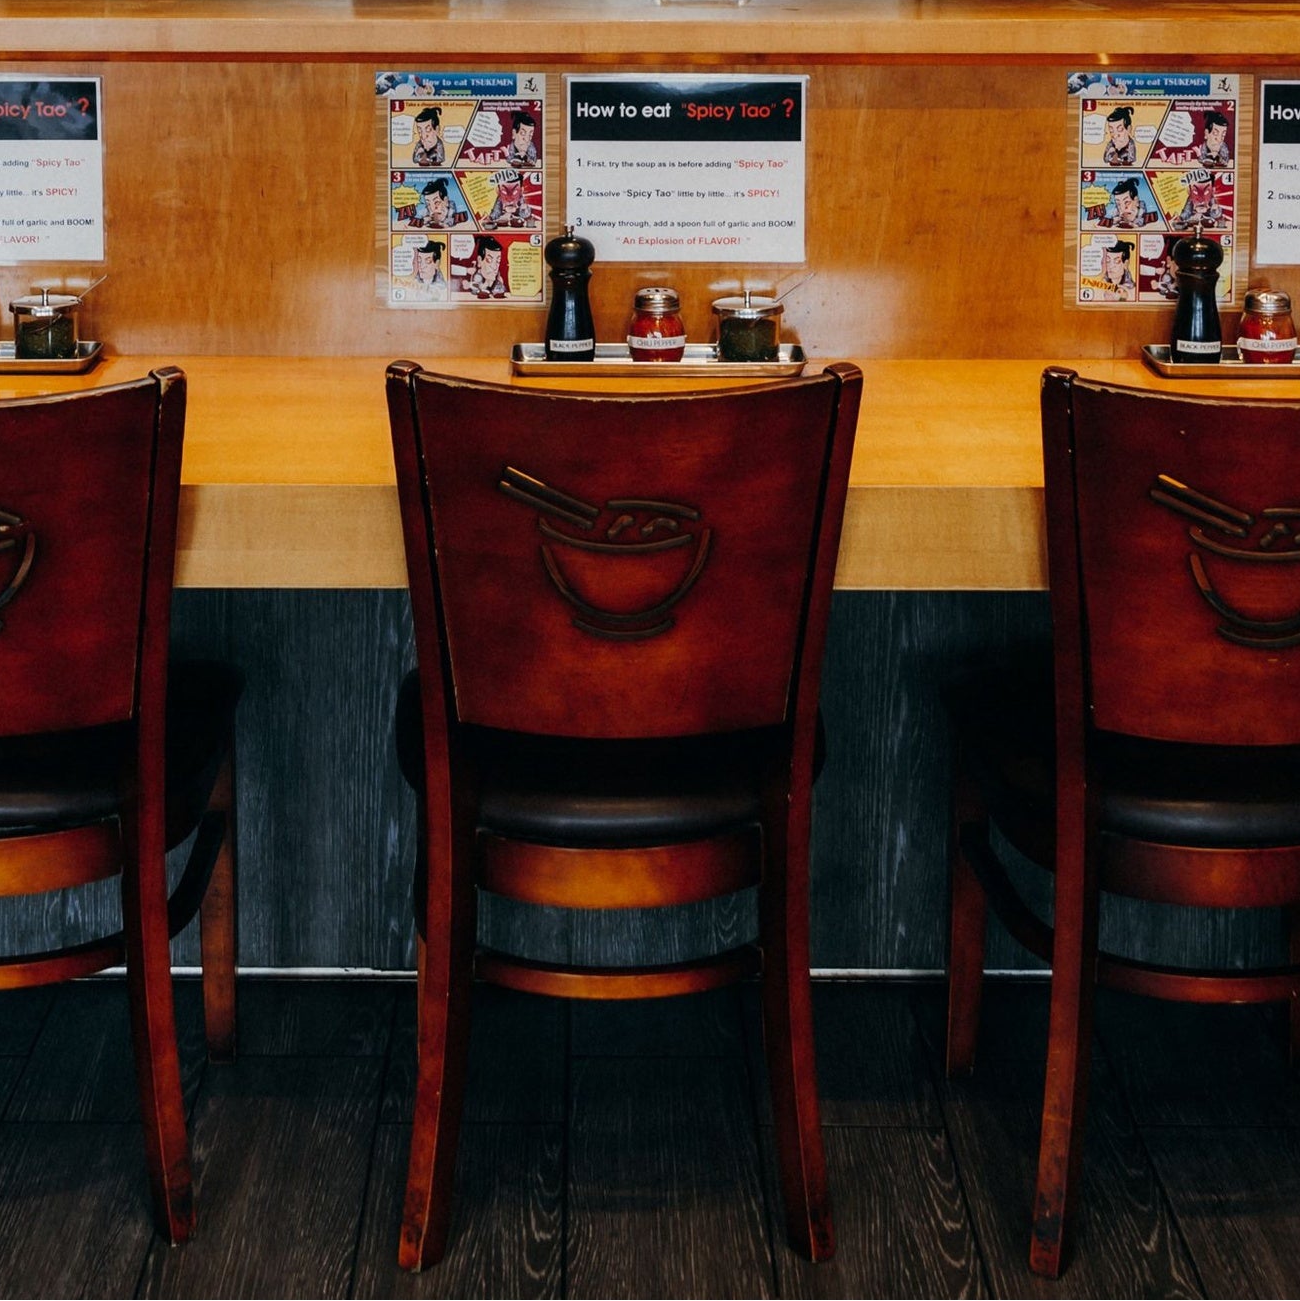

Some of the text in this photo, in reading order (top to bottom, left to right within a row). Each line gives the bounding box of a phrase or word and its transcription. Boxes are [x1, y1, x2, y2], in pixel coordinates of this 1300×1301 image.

[423, 78, 439, 86] How
[454, 78, 468, 87] eat
[471, 78, 514, 86] TSUKEMEN
[1116, 78, 1207, 86] How to eat TSUKEMEN
[35, 101, 72, 117] Tao"
[77, 97, 89, 117] ?
[576, 98, 794, 121] How to eat "Spicy Tao" ?
